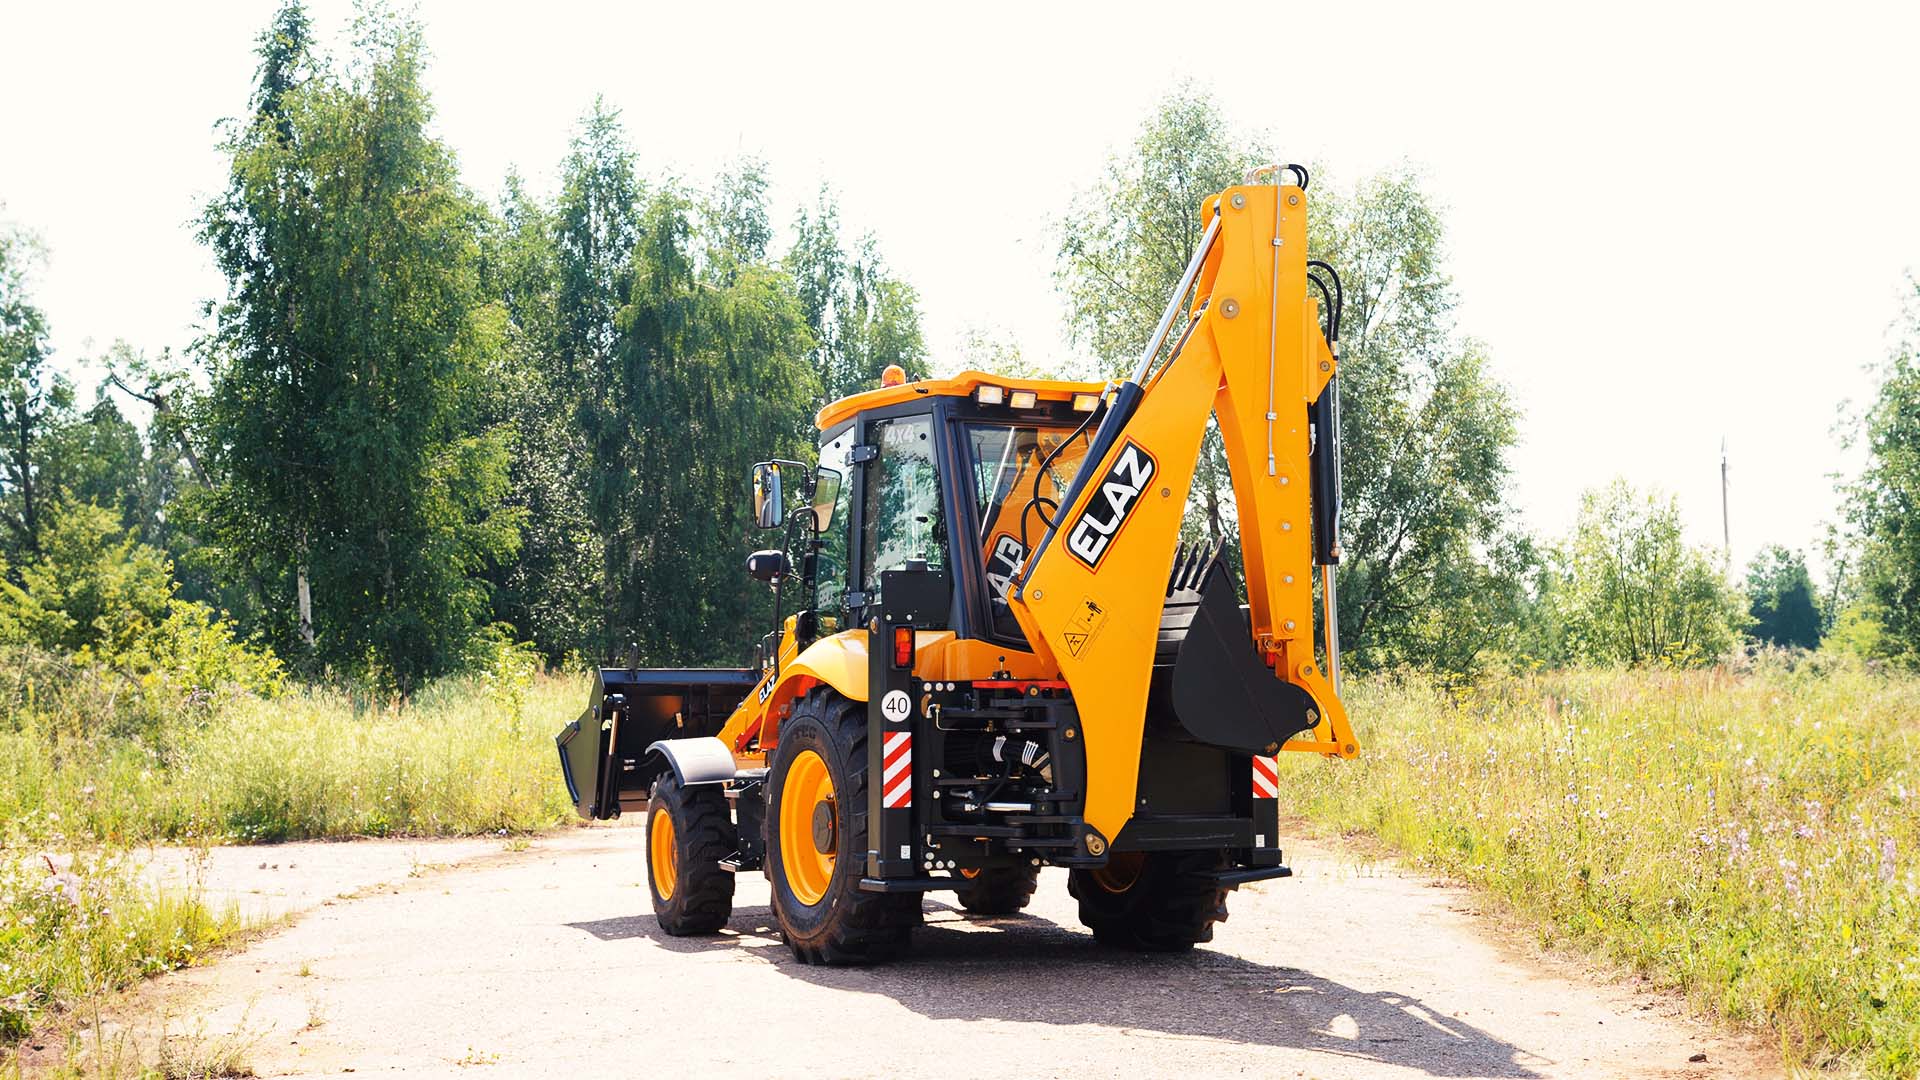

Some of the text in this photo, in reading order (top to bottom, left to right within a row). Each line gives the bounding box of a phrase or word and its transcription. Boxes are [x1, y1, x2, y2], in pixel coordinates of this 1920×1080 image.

[1070, 446, 1153, 564] ELAZ
[759, 675, 775, 704] ELAZ
[886, 697, 908, 714] 40
